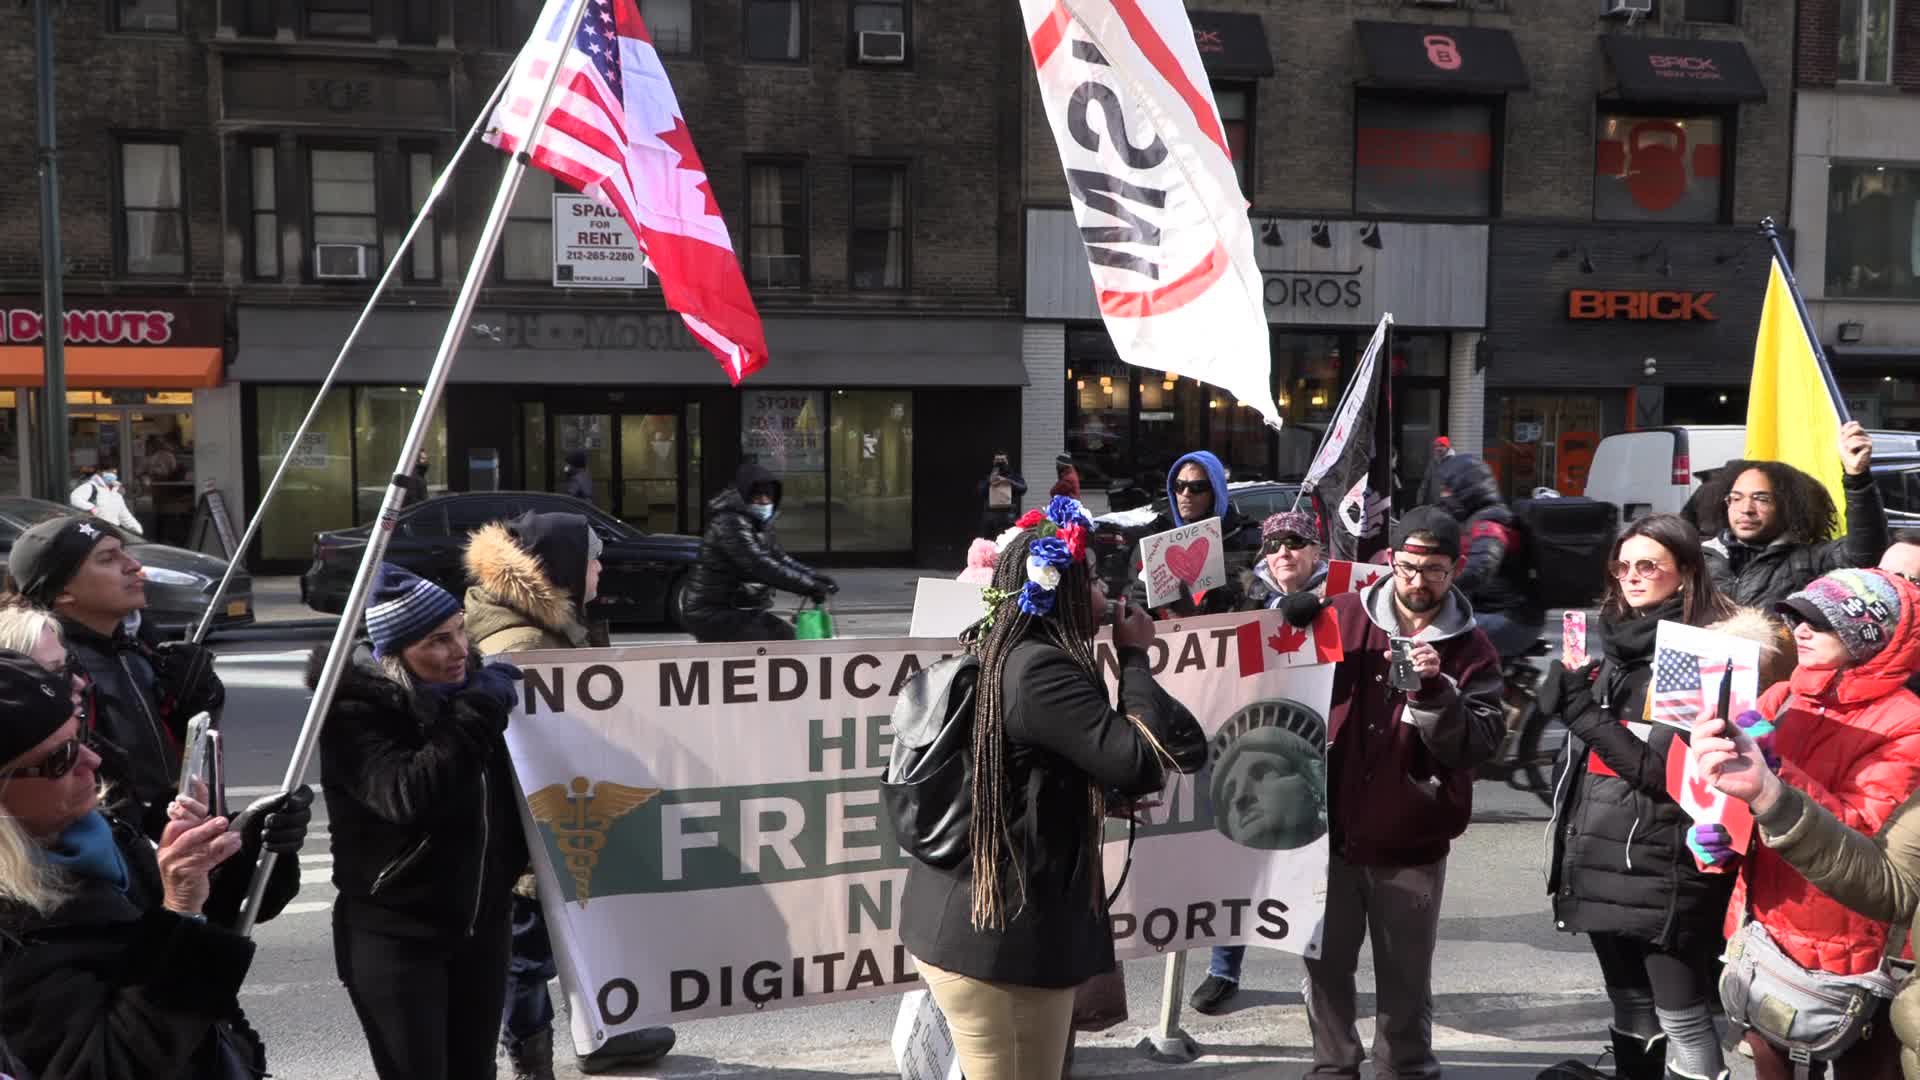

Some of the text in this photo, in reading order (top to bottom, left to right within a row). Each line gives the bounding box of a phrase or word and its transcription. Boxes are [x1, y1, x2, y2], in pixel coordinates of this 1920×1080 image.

[572, 204, 624, 218] SPAC
[590, 220, 611, 229] FOR
[577, 232, 622, 245] RENT
[1263, 277, 1362, 308] OROS
[1568, 289, 1719, 321] BRICK
[9, 309, 171, 344] DNUTS
[523, 664, 624, 714] NO
[659, 653, 953, 707] MEDICA
[597, 898, 1289, 1026] O DIGITAL PORTS
